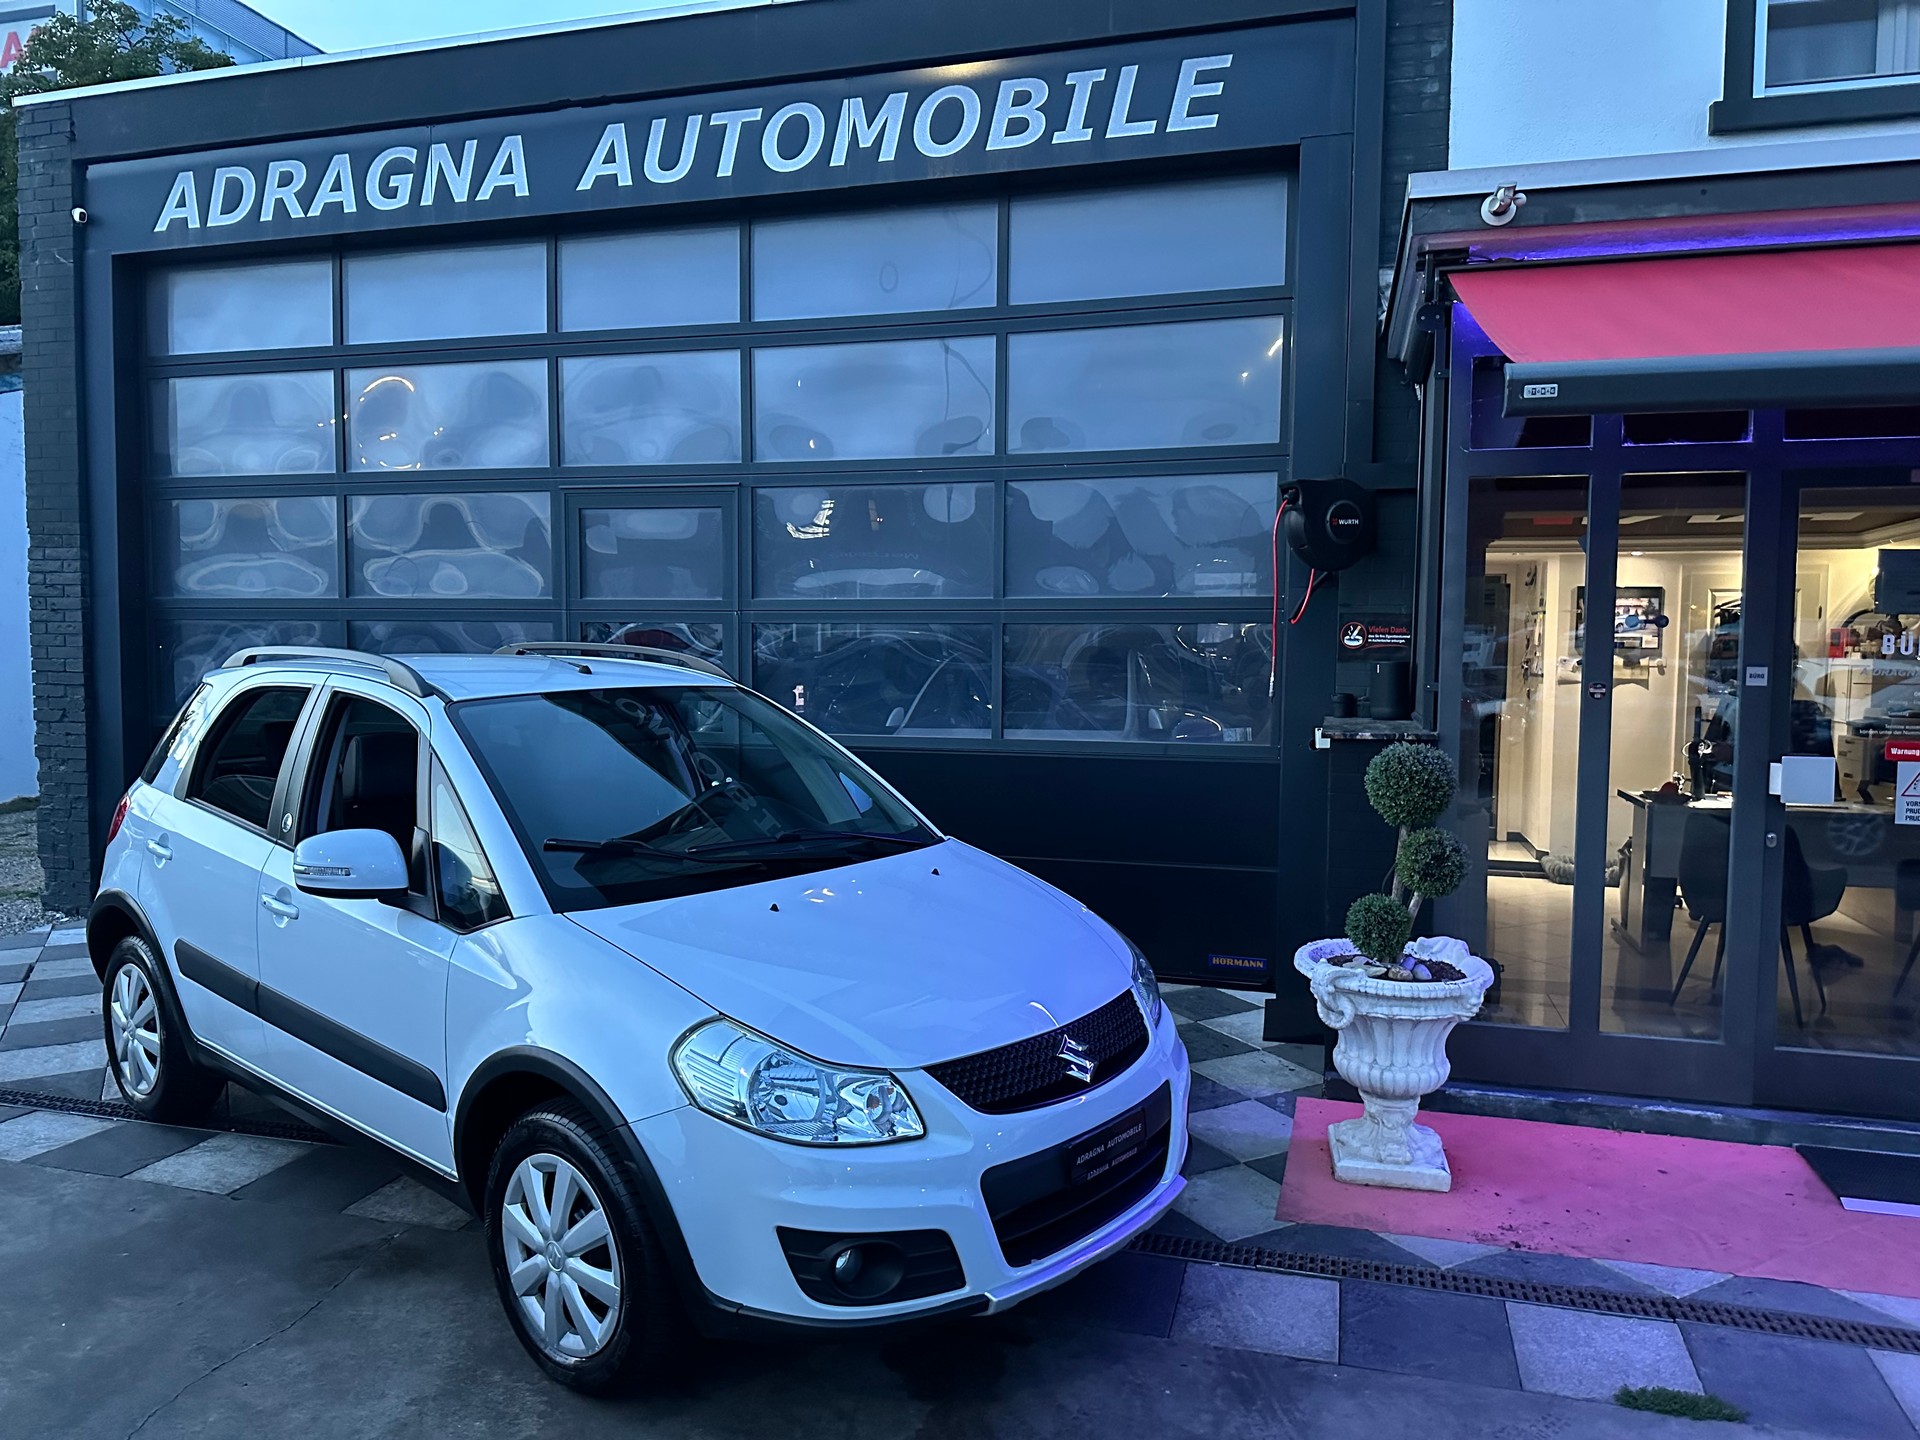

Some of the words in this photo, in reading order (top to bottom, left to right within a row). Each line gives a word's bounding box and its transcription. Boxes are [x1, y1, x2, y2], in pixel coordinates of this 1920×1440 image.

[154, 134, 530, 233] ADRAGNA
[576, 53, 1233, 191] AUTOMOBILE
[1076, 1144, 1105, 1166] ADRAGNA
[1107, 1123, 1142, 1149] AUTOMOBILE
